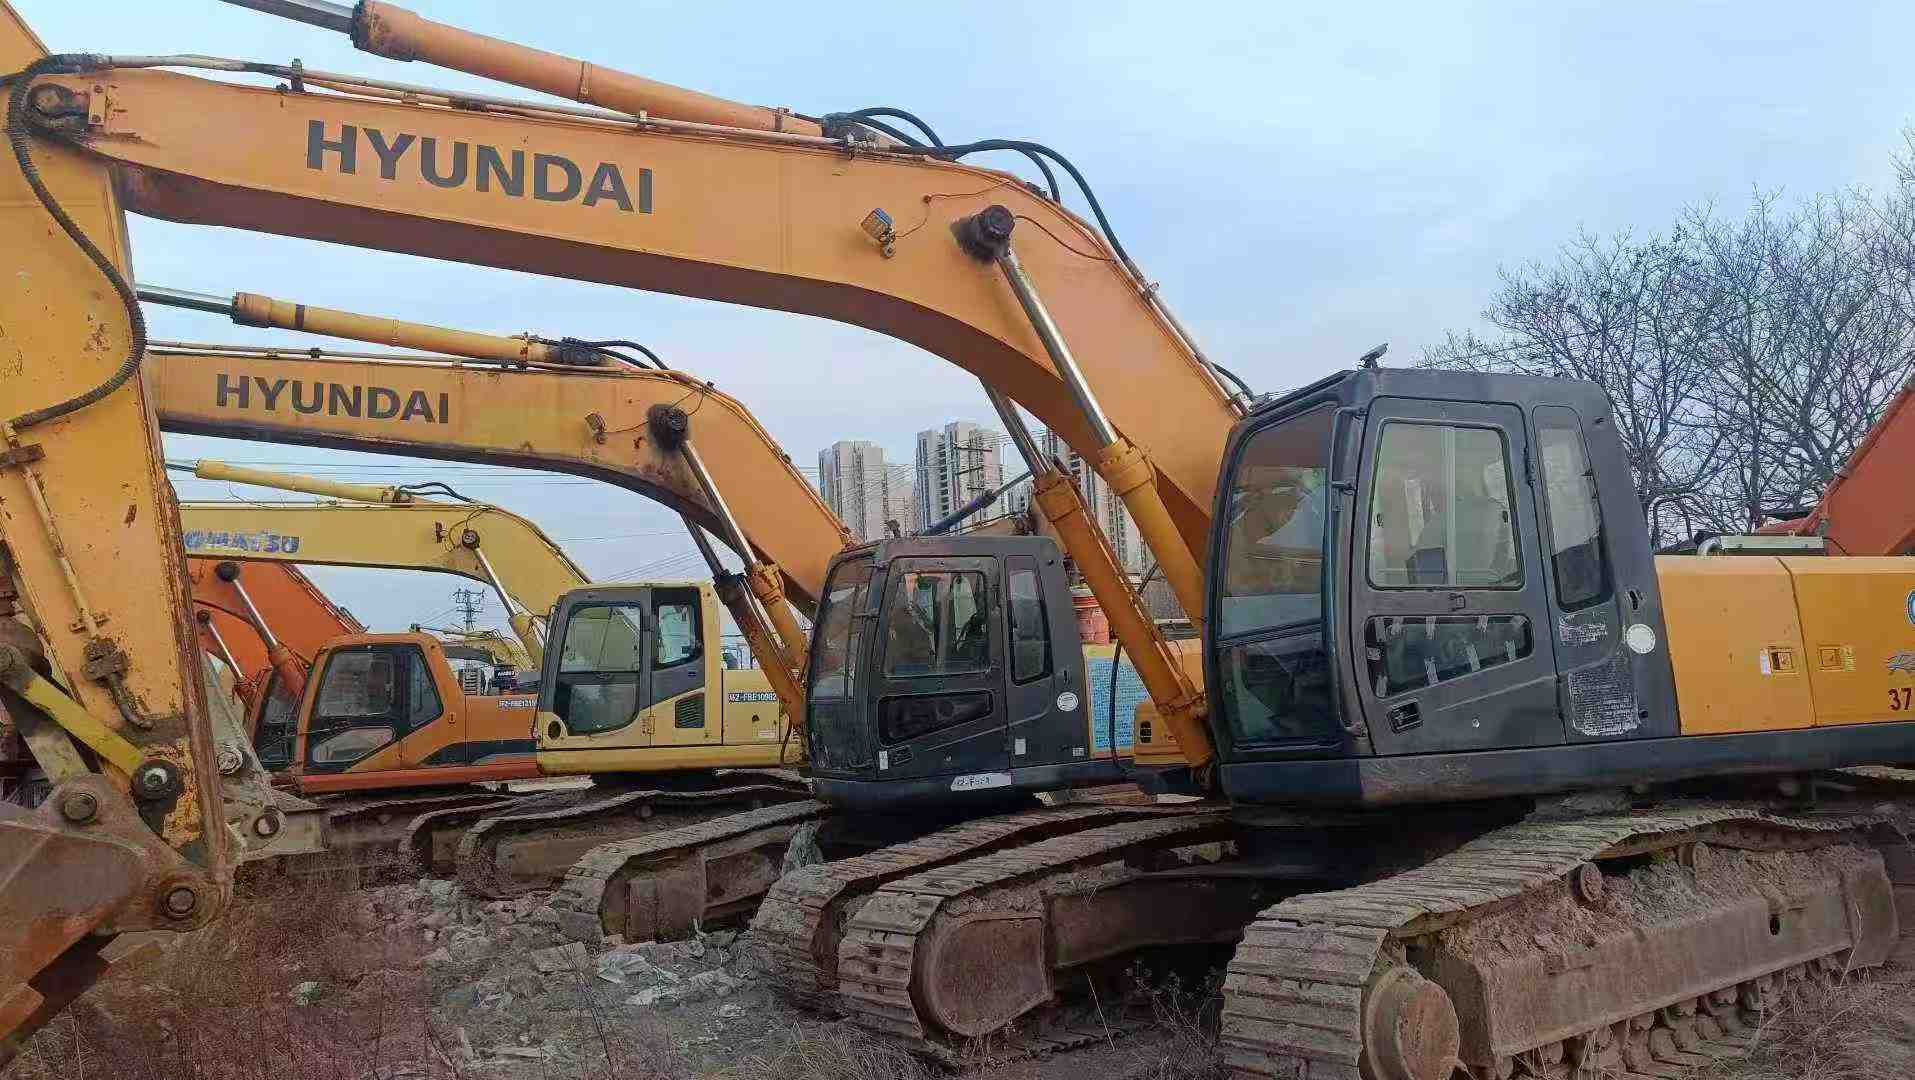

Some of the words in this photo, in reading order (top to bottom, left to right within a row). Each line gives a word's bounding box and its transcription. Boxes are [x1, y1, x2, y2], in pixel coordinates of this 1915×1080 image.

[306, 120, 653, 214] HYUNDAI
[216, 374, 449, 424] HYUNDAI
[184, 531, 300, 553] OMATSU
[1887, 687, 1912, 711] 37
